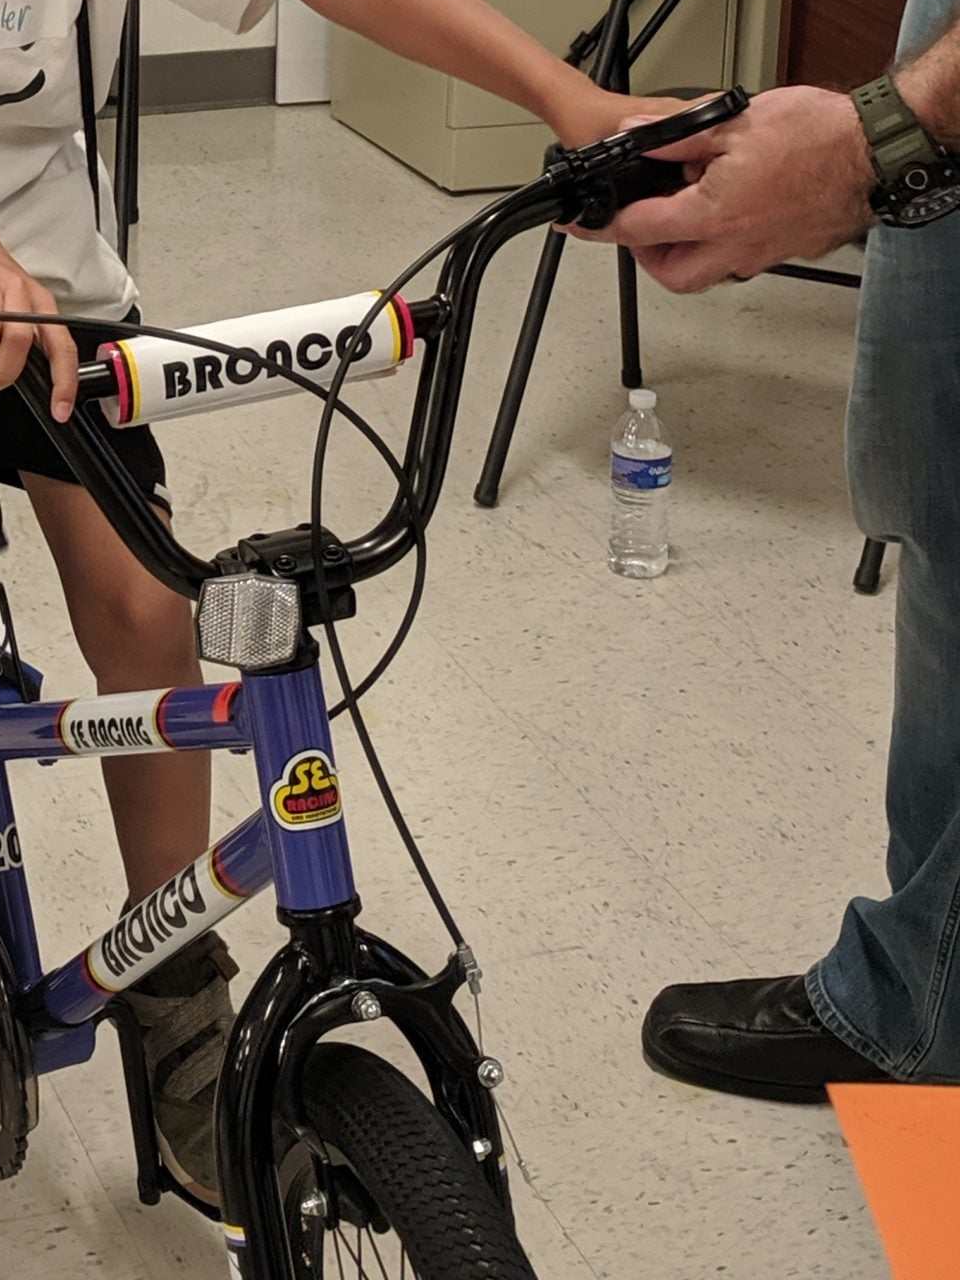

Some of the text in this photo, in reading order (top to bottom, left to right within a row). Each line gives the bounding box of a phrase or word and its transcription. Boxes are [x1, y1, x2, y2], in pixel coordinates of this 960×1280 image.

[161, 324, 373, 400] BRONCO
[87, 715, 154, 748] RACING
[291, 760, 331, 795] SE
[101, 862, 207, 977] BRONCO
